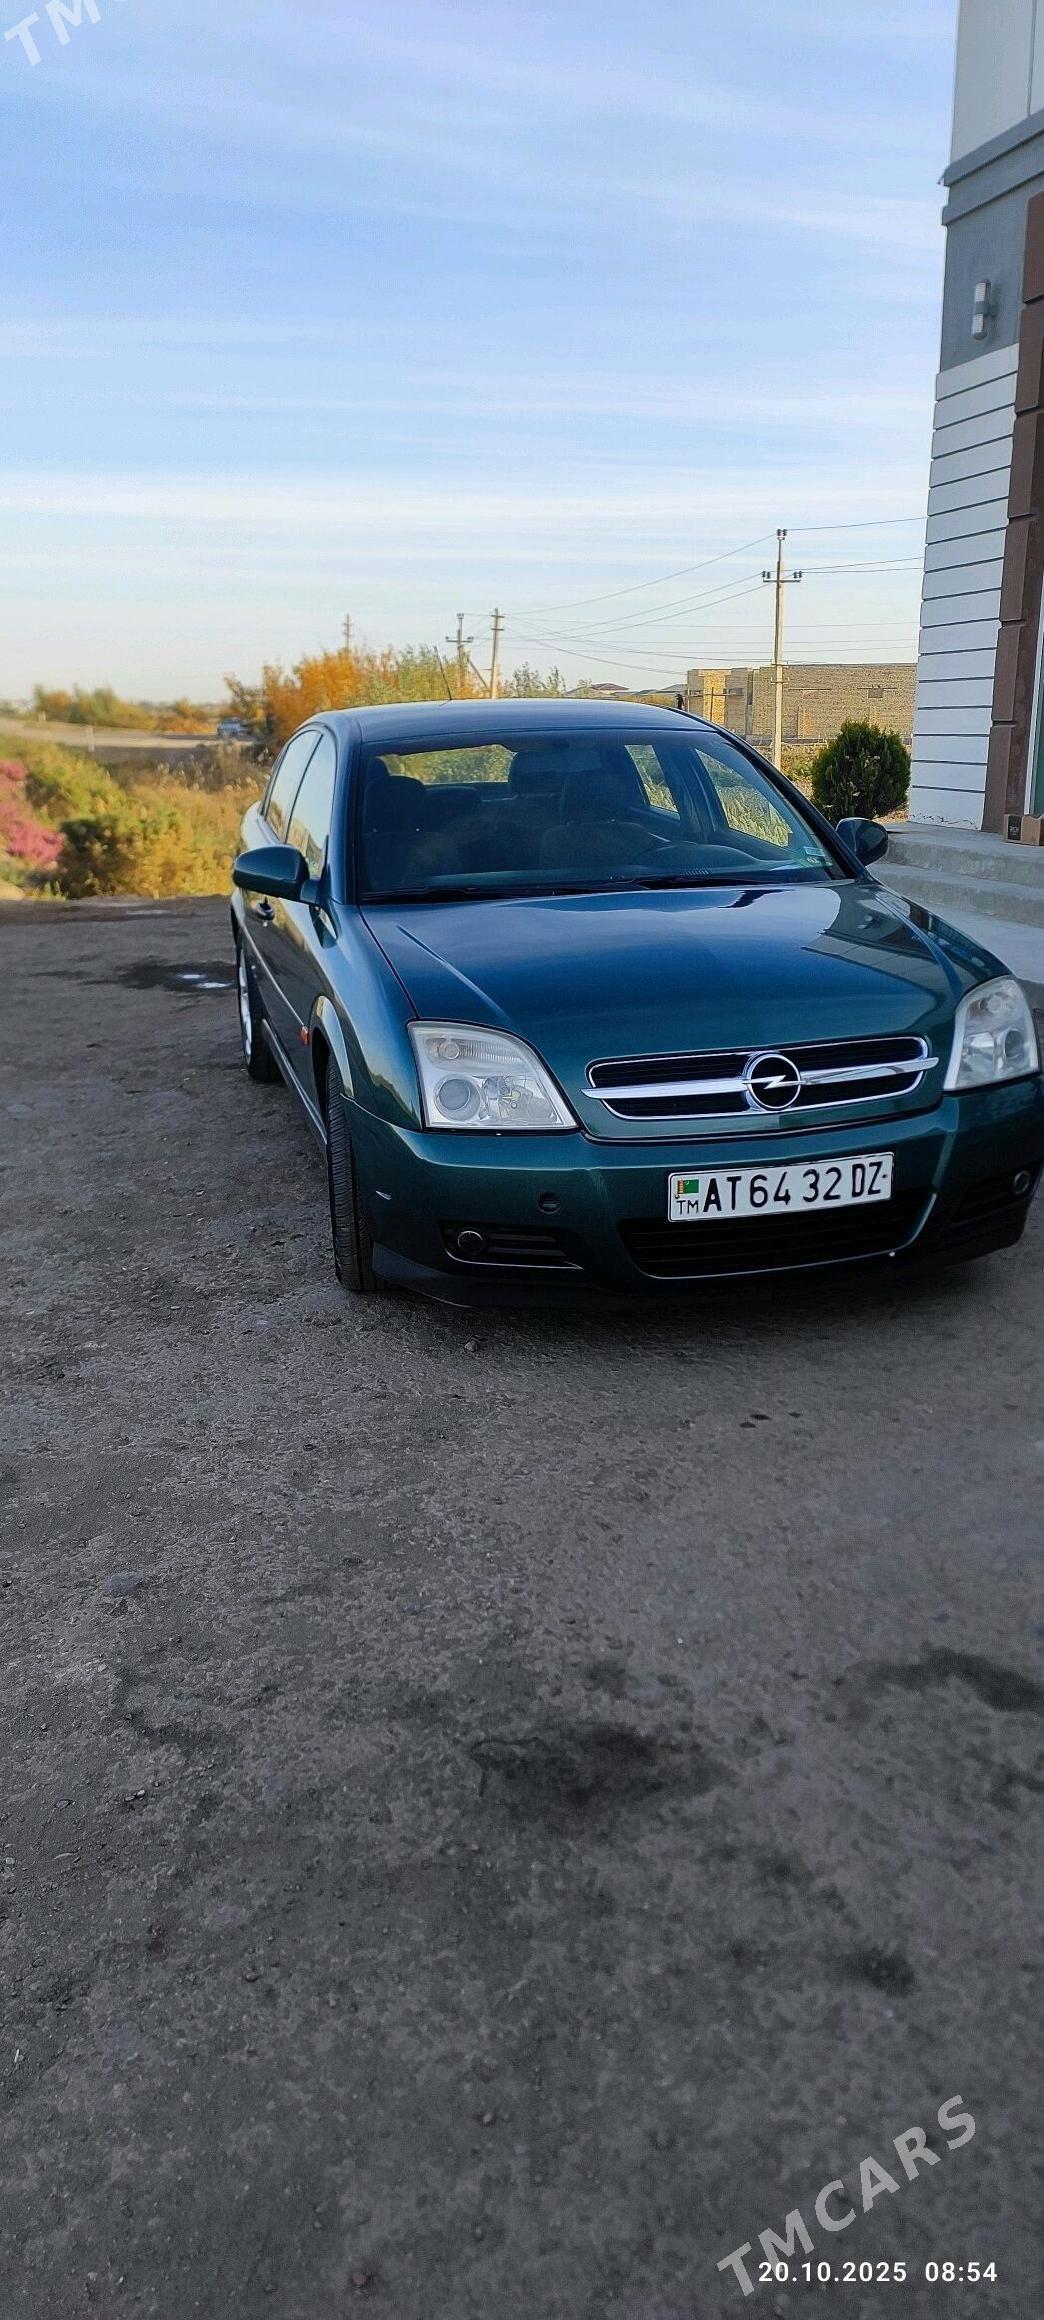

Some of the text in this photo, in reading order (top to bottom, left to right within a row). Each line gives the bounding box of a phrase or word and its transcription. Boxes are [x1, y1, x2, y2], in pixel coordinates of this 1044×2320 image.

[676, 1199, 699, 1214] TM
[802, 1166, 842, 1203] 32
[851, 1160, 883, 1198] DZ
